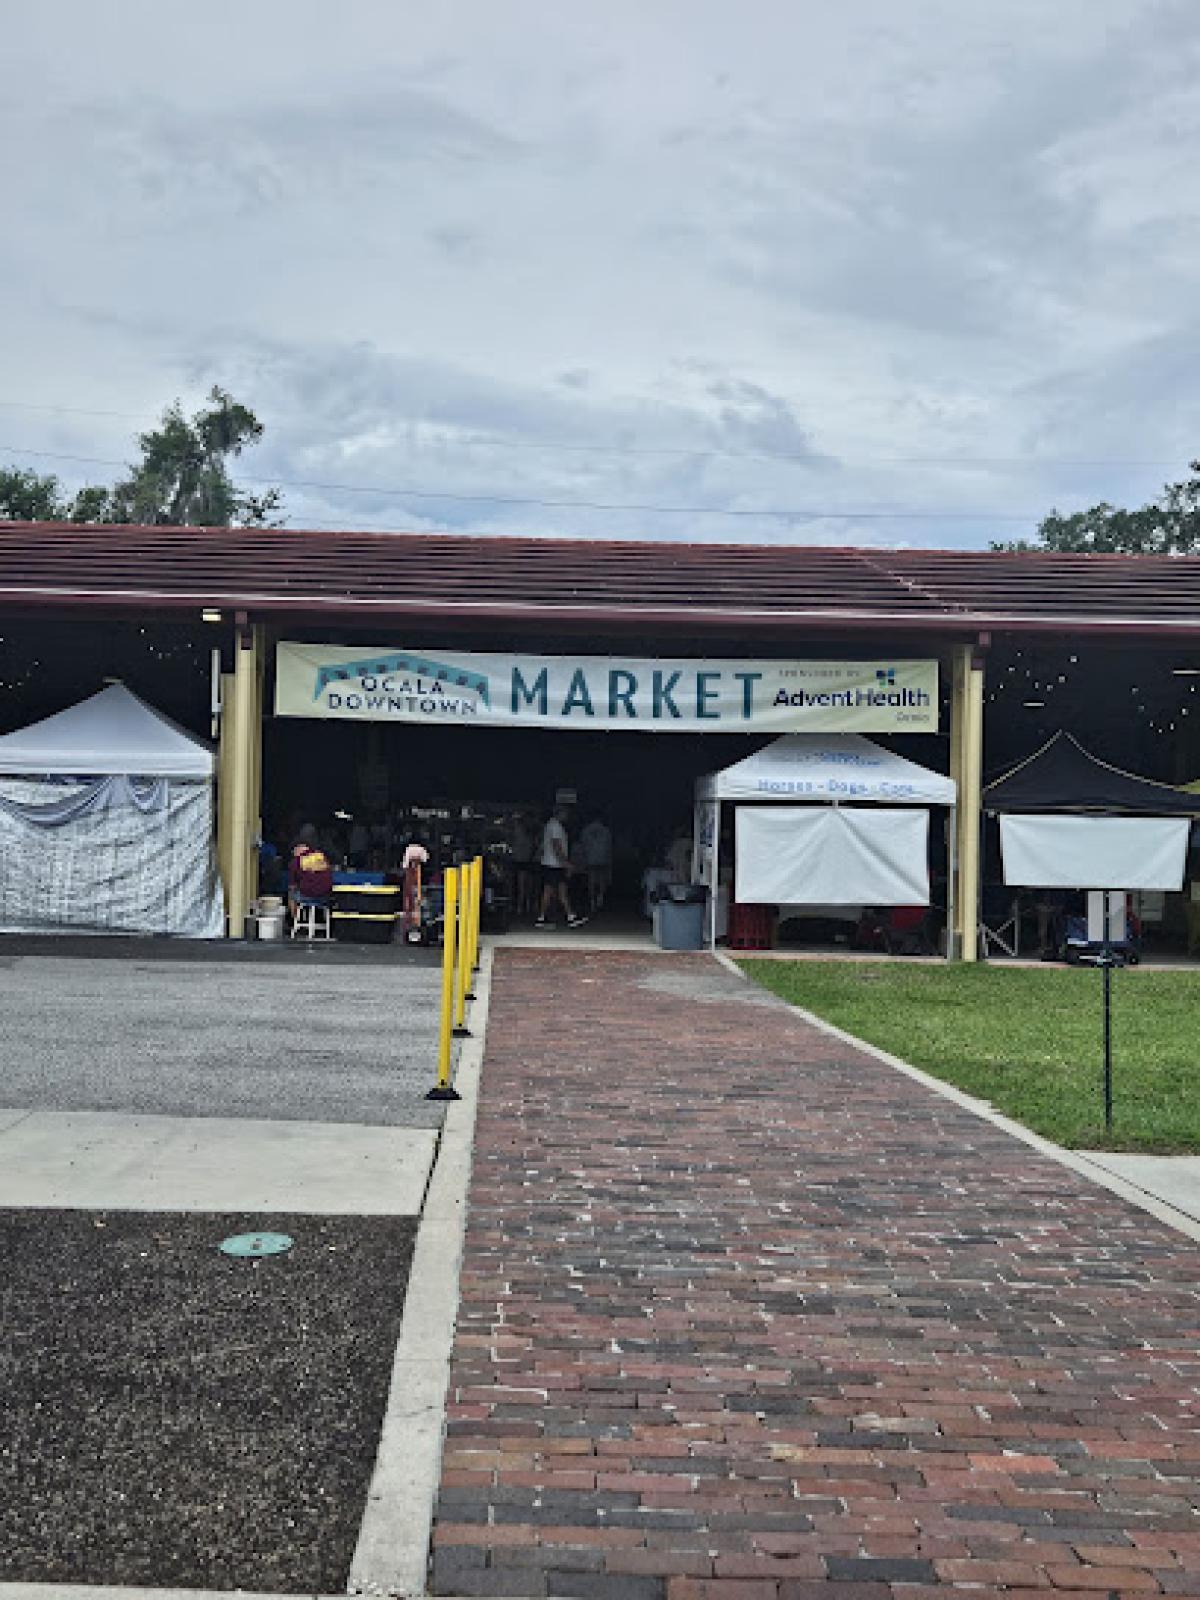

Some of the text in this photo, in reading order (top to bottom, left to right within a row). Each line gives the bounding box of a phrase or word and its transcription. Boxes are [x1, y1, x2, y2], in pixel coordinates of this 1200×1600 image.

[361, 676, 443, 695] OCALA
[511, 666, 762, 719] MARKET
[328, 693, 477, 716] DOWNTOWN
[773, 688, 930, 707] AdventHealth
